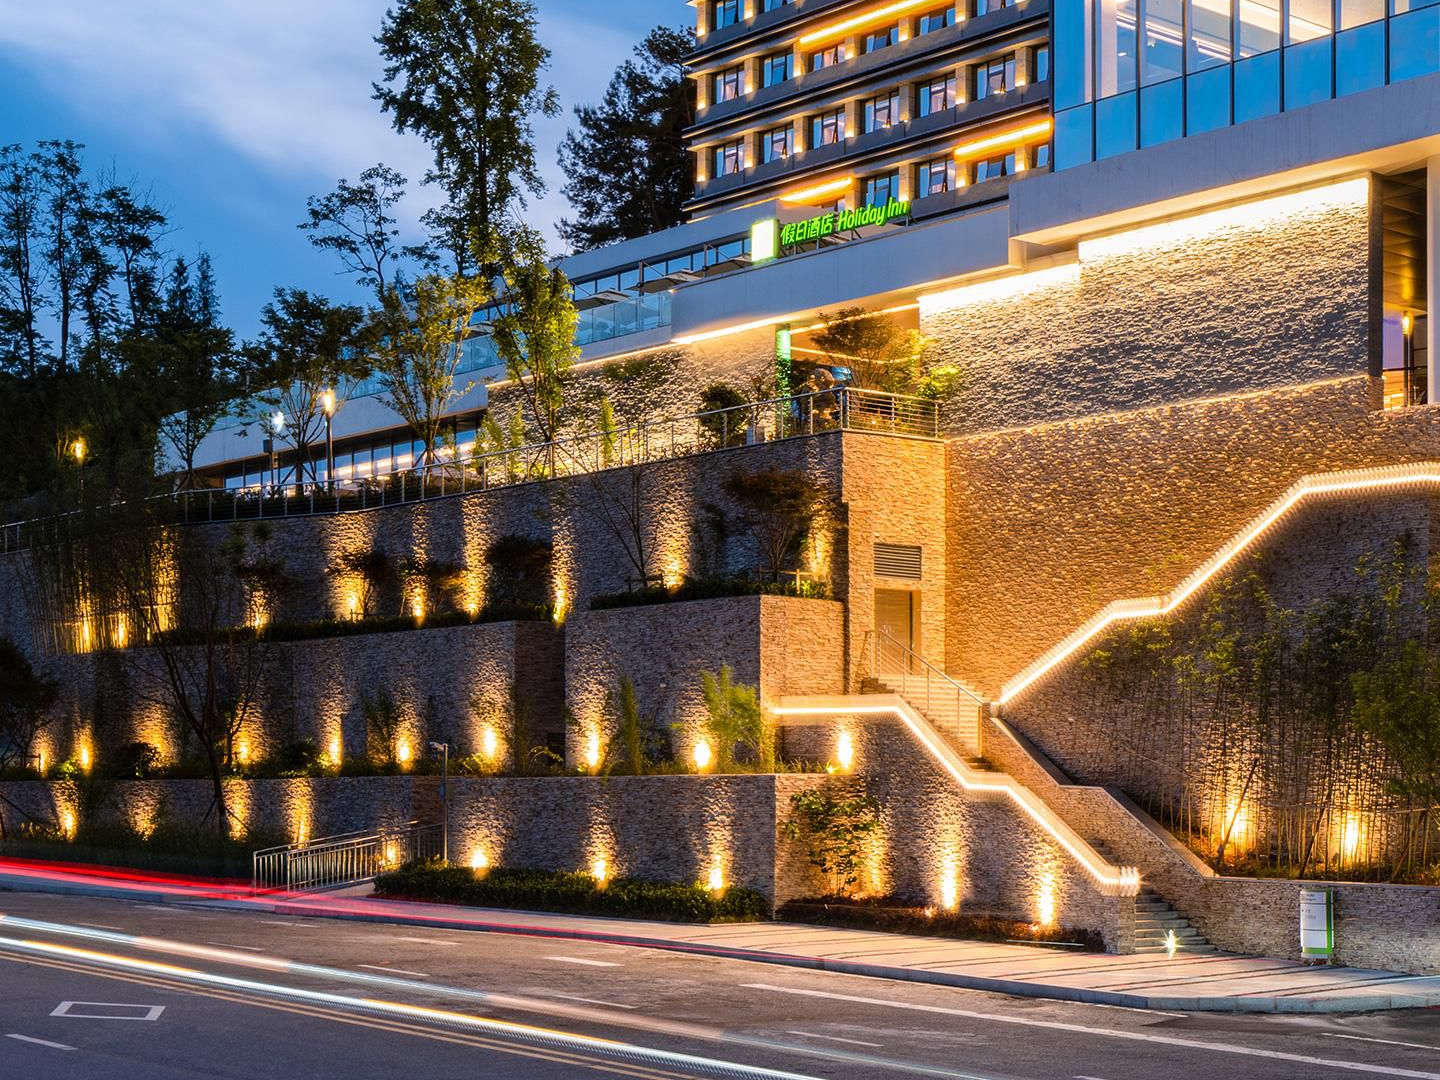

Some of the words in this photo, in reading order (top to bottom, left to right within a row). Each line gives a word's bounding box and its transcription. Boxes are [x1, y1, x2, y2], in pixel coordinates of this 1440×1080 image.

[781, 212, 833, 246] 假日酒店
[837, 205, 887, 232] Holiday
[887, 197, 909, 218] Inn
